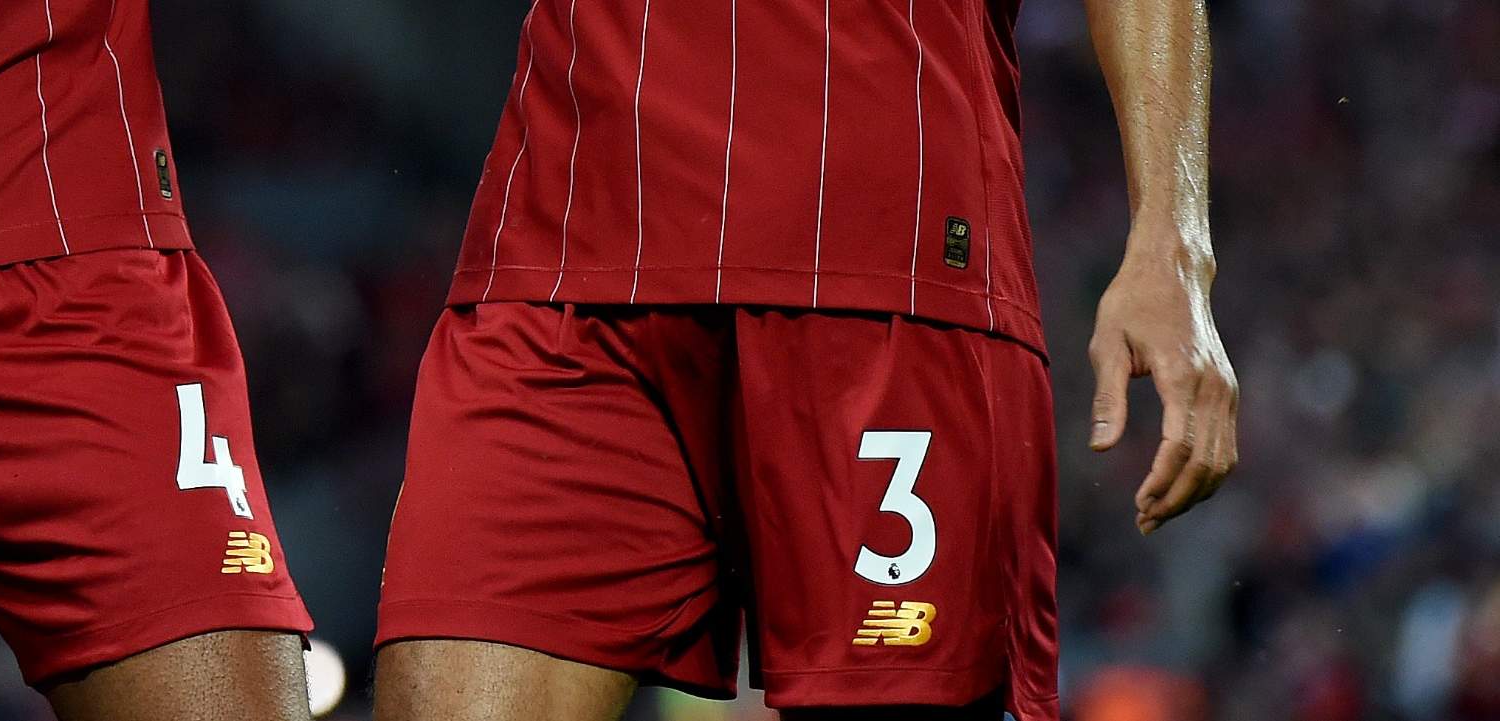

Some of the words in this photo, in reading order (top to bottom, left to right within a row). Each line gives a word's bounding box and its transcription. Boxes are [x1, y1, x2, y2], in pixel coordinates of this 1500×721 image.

[176, 383, 254, 520] 4
[221, 531, 275, 574] NB
[854, 431, 937, 585] 3
[852, 601, 937, 646] NB
